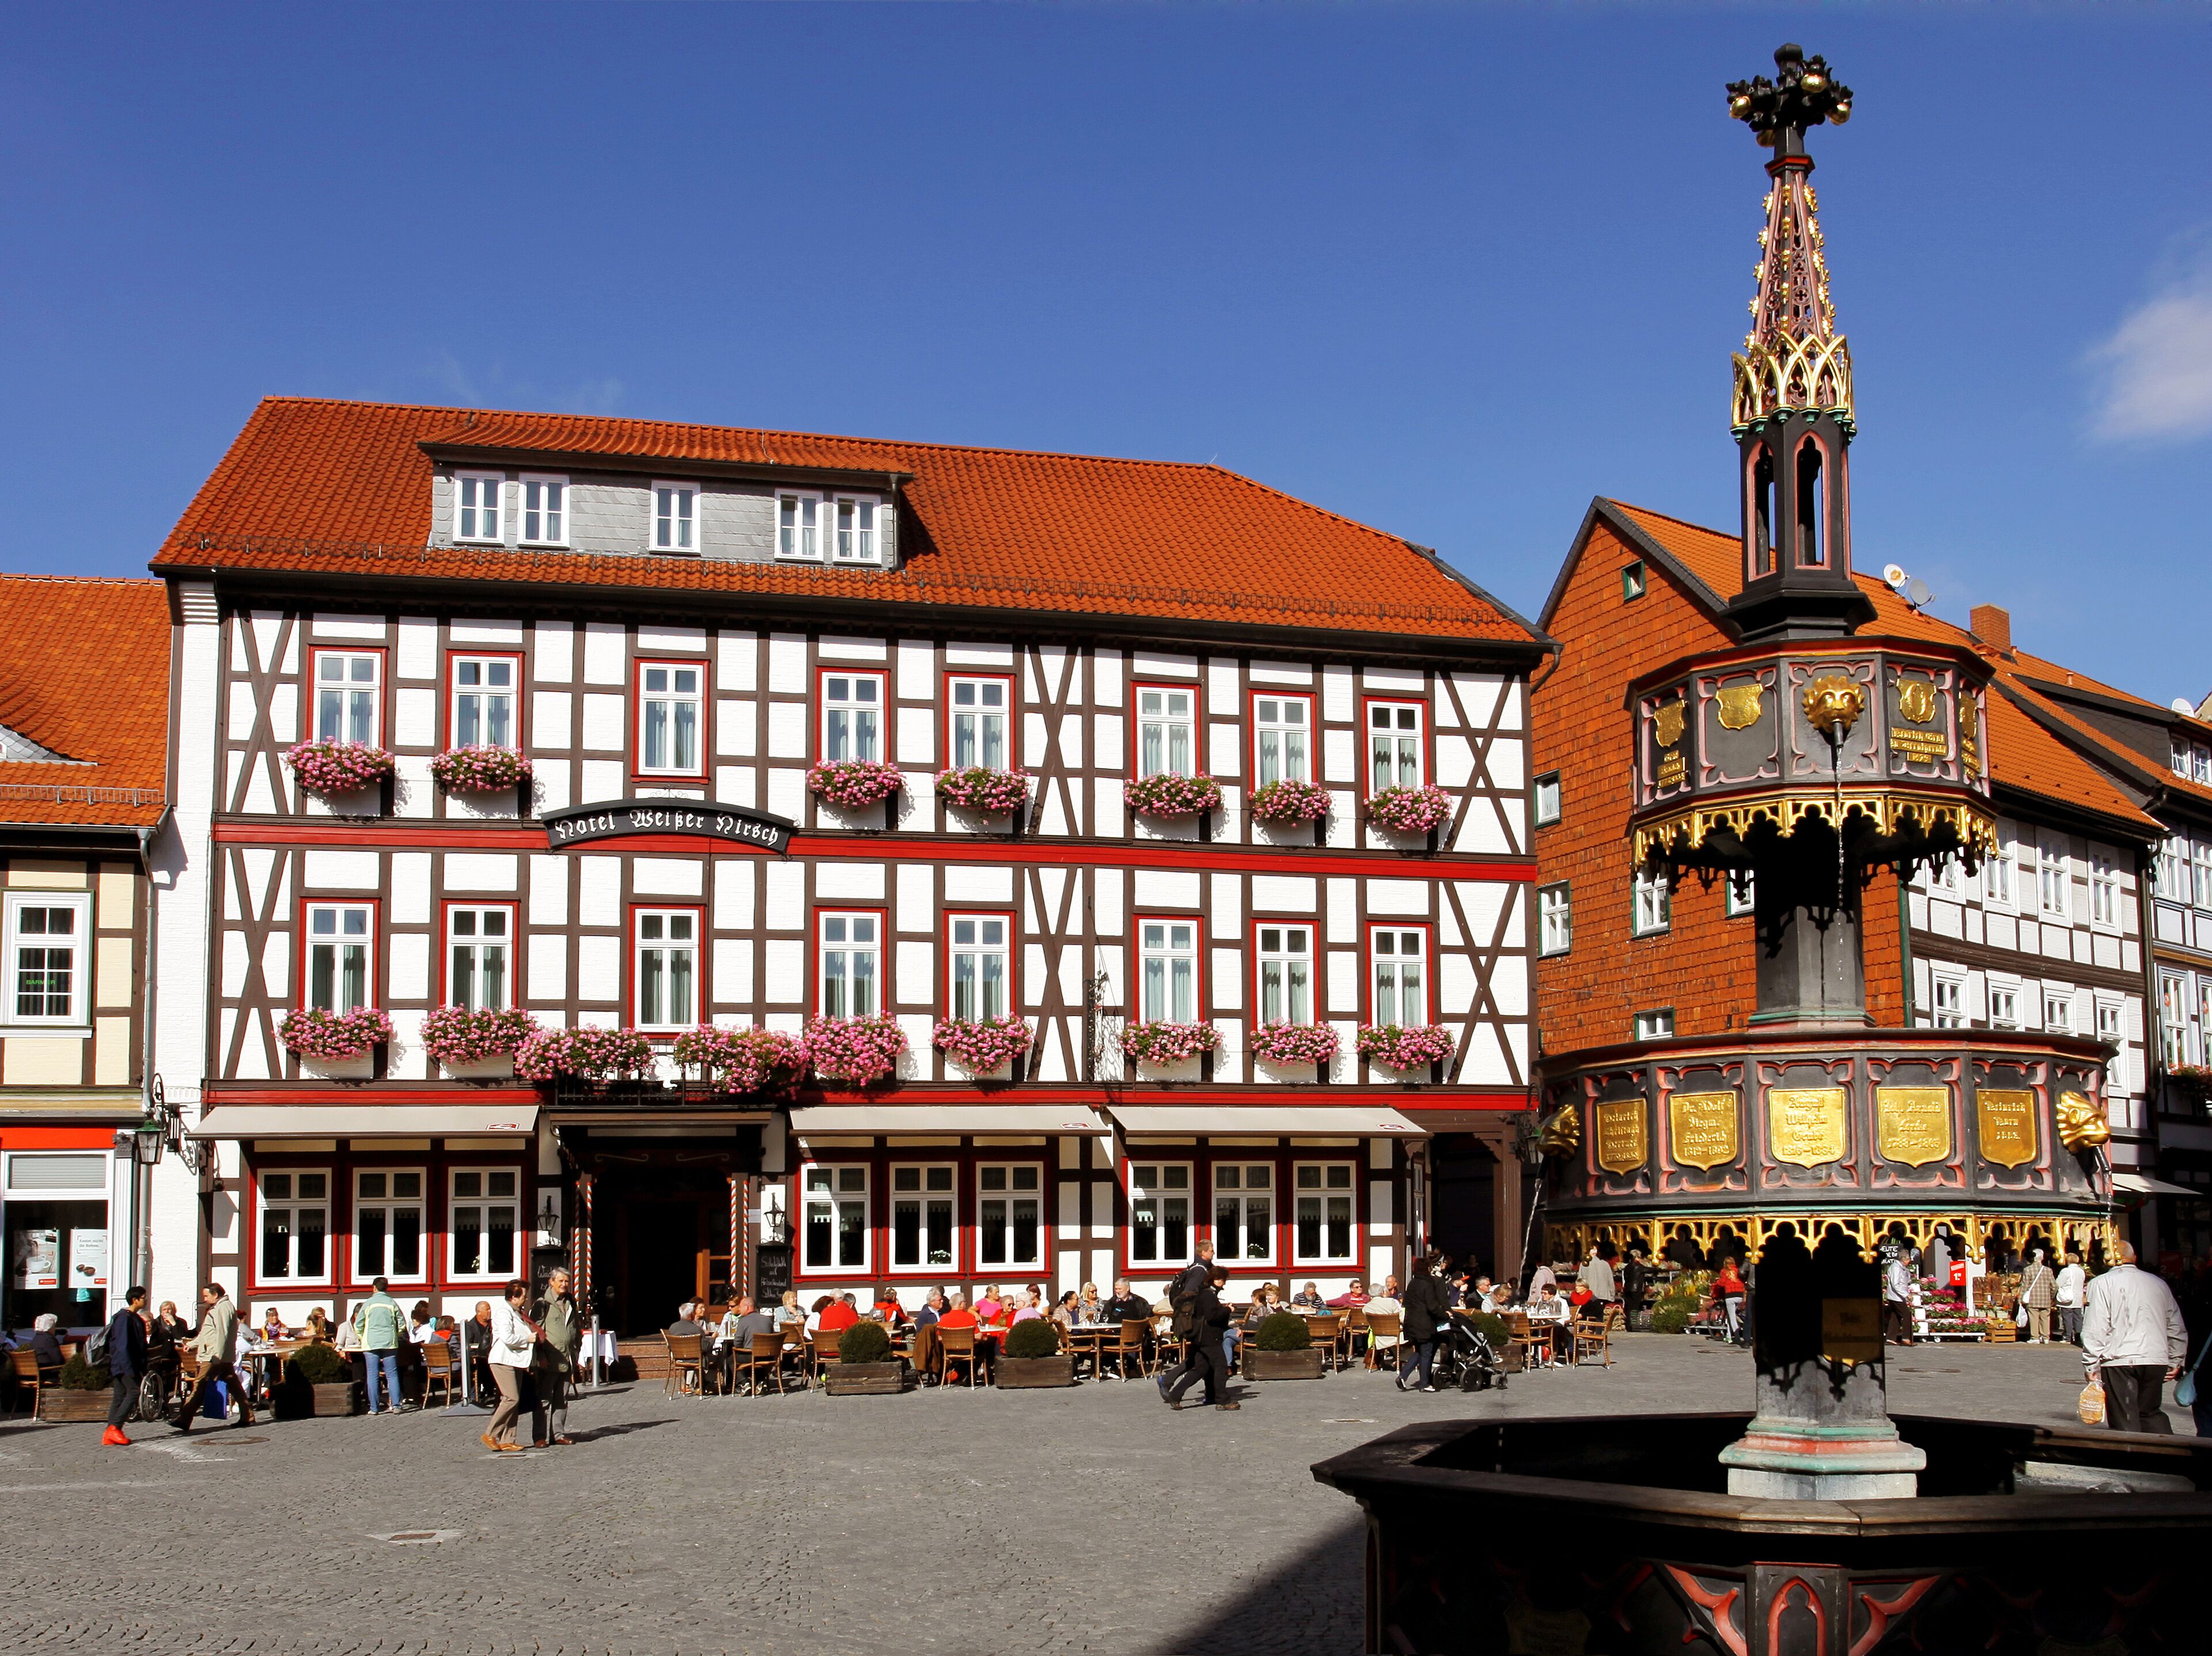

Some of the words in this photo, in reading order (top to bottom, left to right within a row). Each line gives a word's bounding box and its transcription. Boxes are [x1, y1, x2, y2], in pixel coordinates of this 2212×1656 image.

[555, 814, 616, 840] Hotel
[629, 809, 704, 831] Weißer
[715, 813, 779, 846] Hirsch
